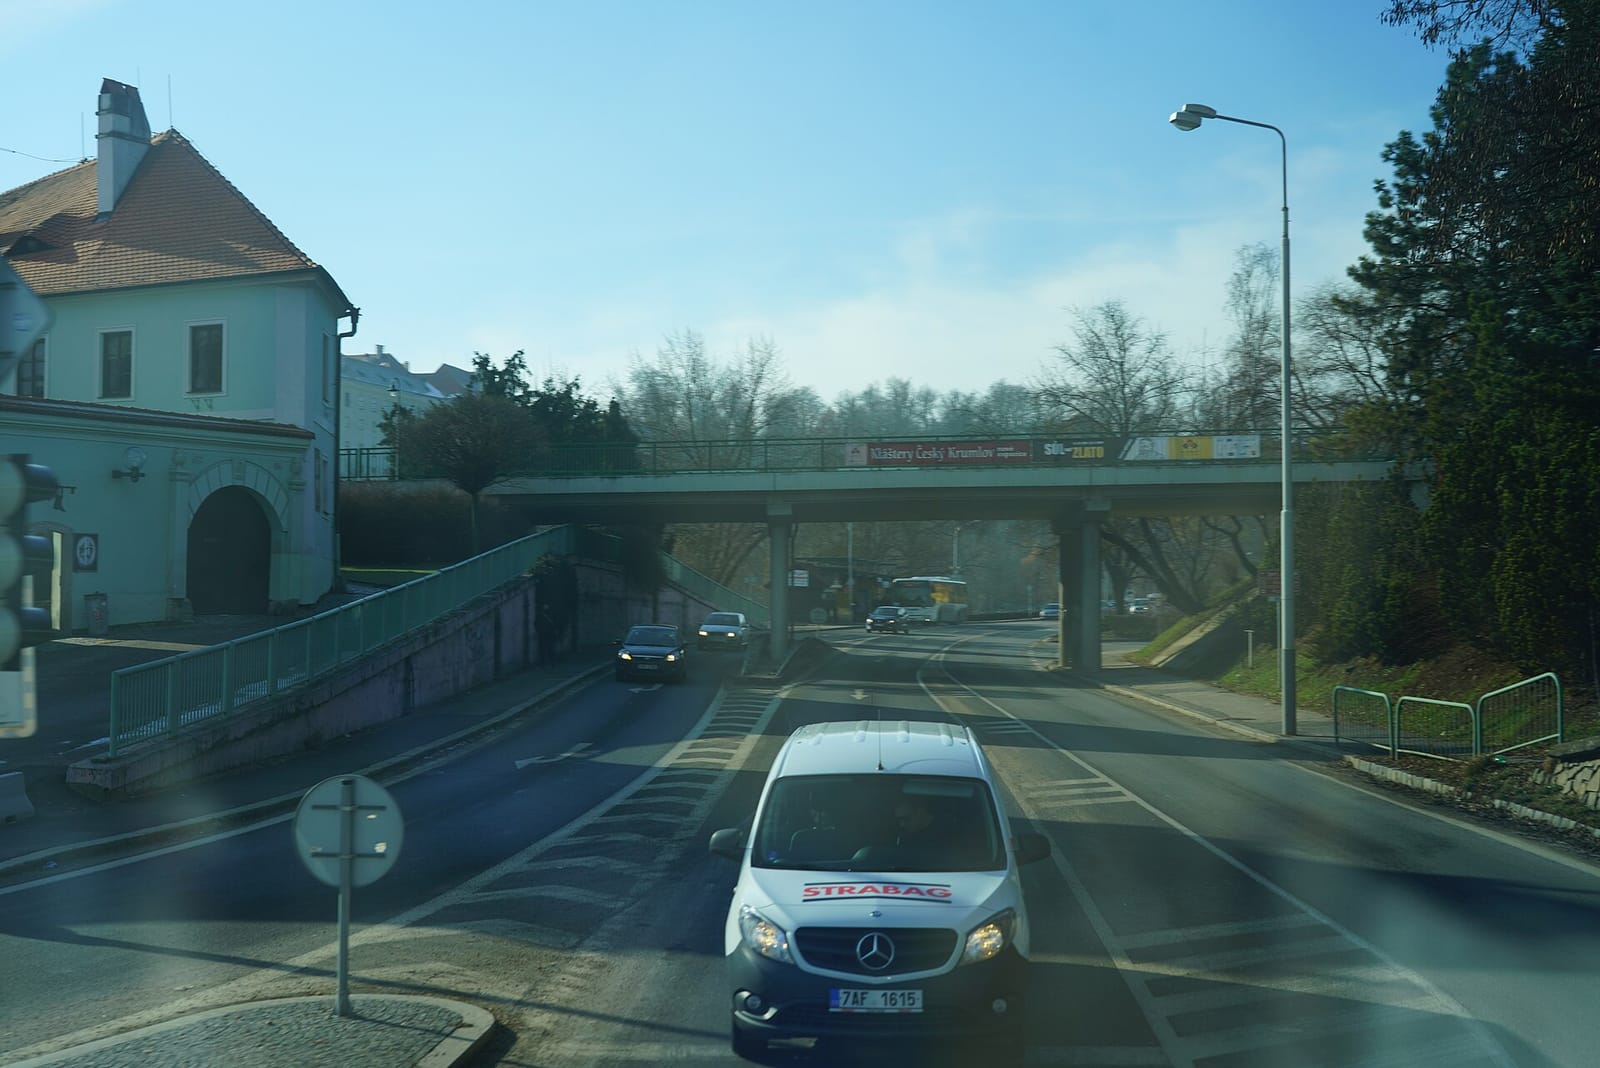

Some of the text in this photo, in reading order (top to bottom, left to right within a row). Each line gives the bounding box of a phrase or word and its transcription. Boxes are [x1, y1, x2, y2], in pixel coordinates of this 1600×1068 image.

[916, 444, 945, 462] Český
[947, 446, 993, 458] Krumlov
[802, 885, 953, 898] STRABAG
[842, 991, 916, 1007] 7AF 1615
